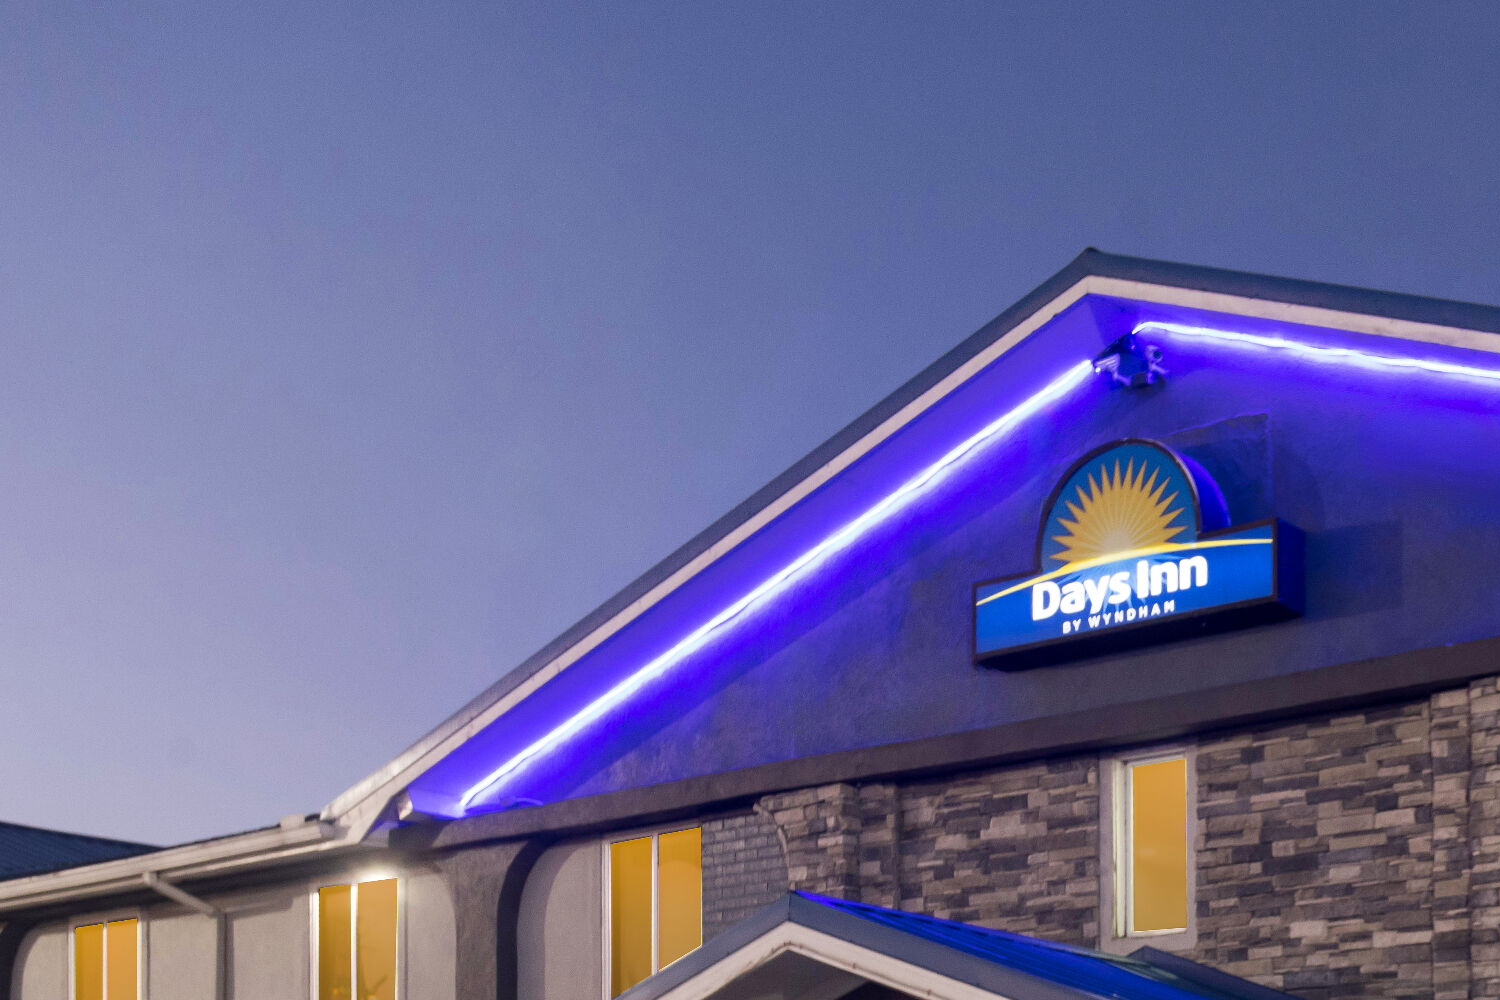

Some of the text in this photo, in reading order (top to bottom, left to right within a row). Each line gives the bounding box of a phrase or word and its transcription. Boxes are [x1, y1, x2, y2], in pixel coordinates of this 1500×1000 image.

[1032, 555, 1208, 621] Days Inn
[1062, 600, 1175, 634] BY WYNDHAM
